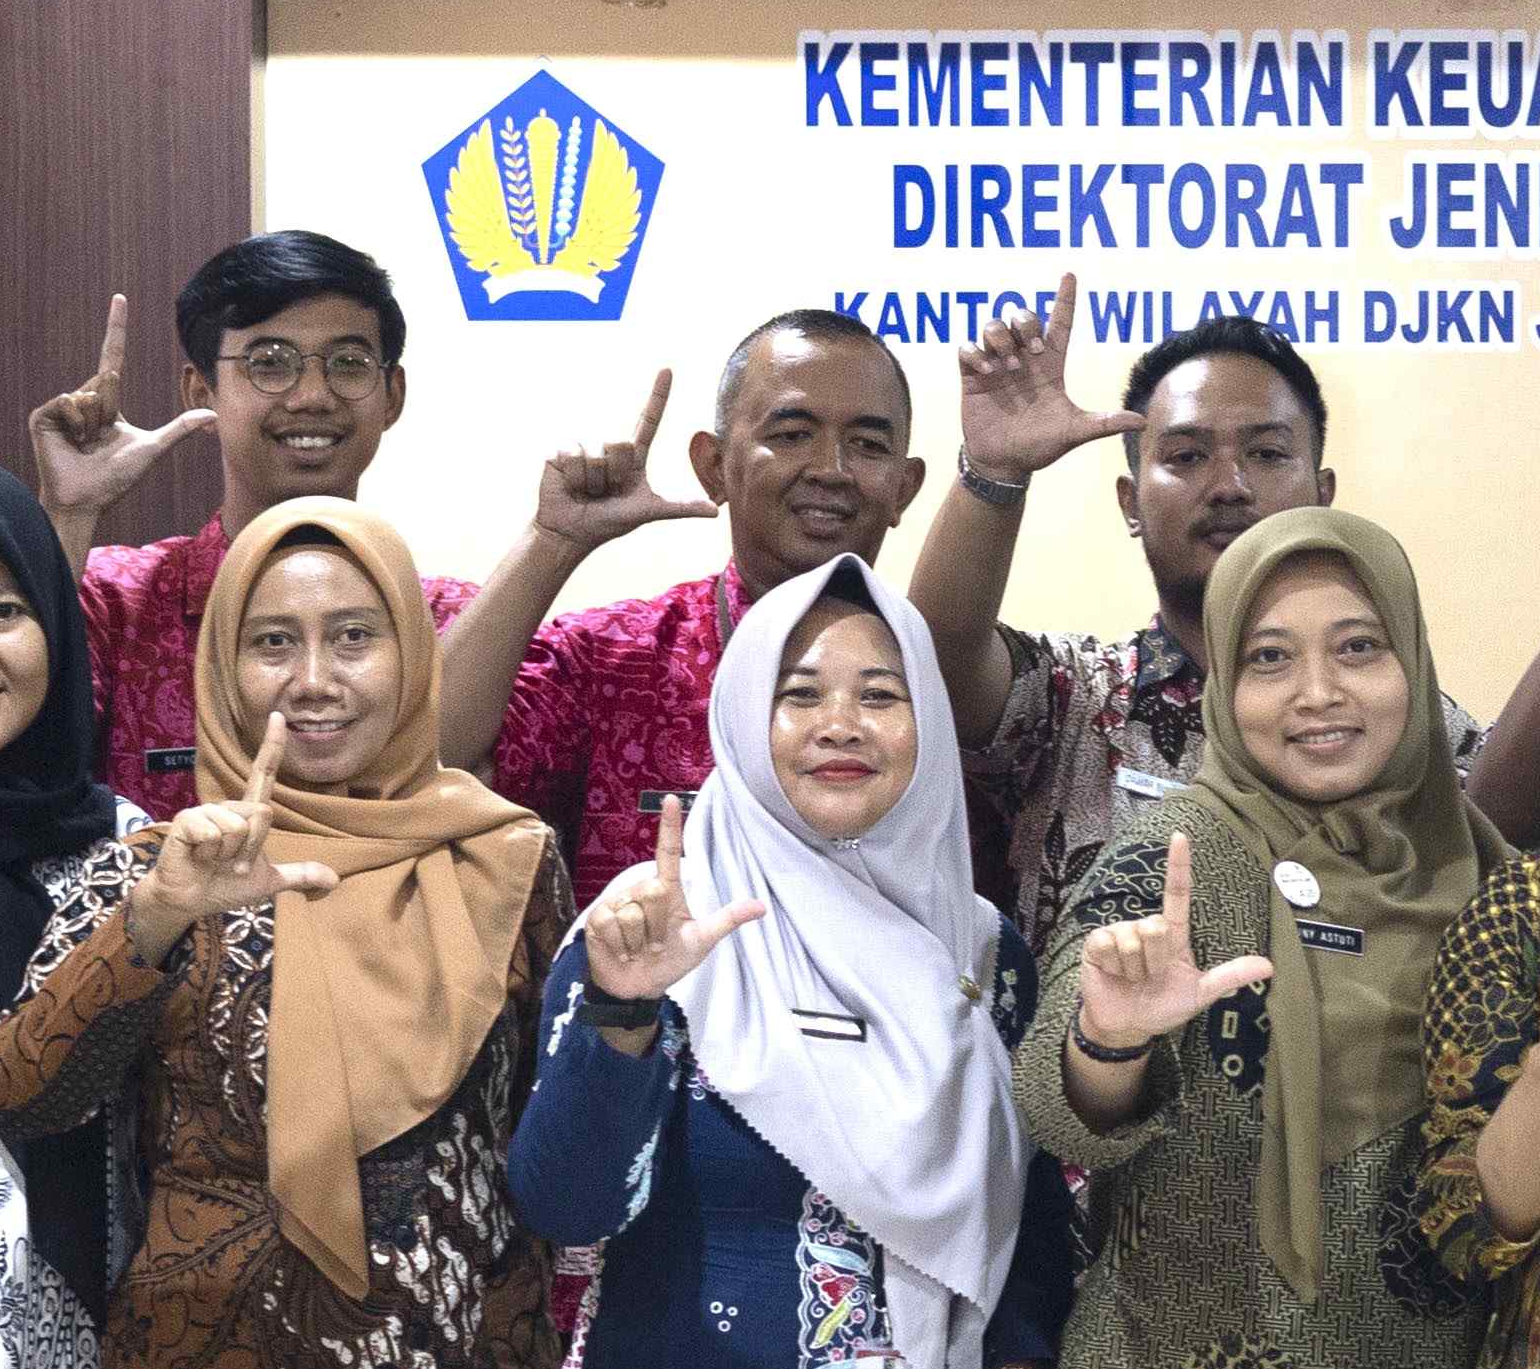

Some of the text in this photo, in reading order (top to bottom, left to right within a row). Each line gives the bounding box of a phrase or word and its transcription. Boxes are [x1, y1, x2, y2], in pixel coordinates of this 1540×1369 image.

[805, 42, 1343, 127] KEMENTERIAN
[893, 162, 1364, 249] DIREKTORAT
[1364, 290, 1514, 343] DJKN
